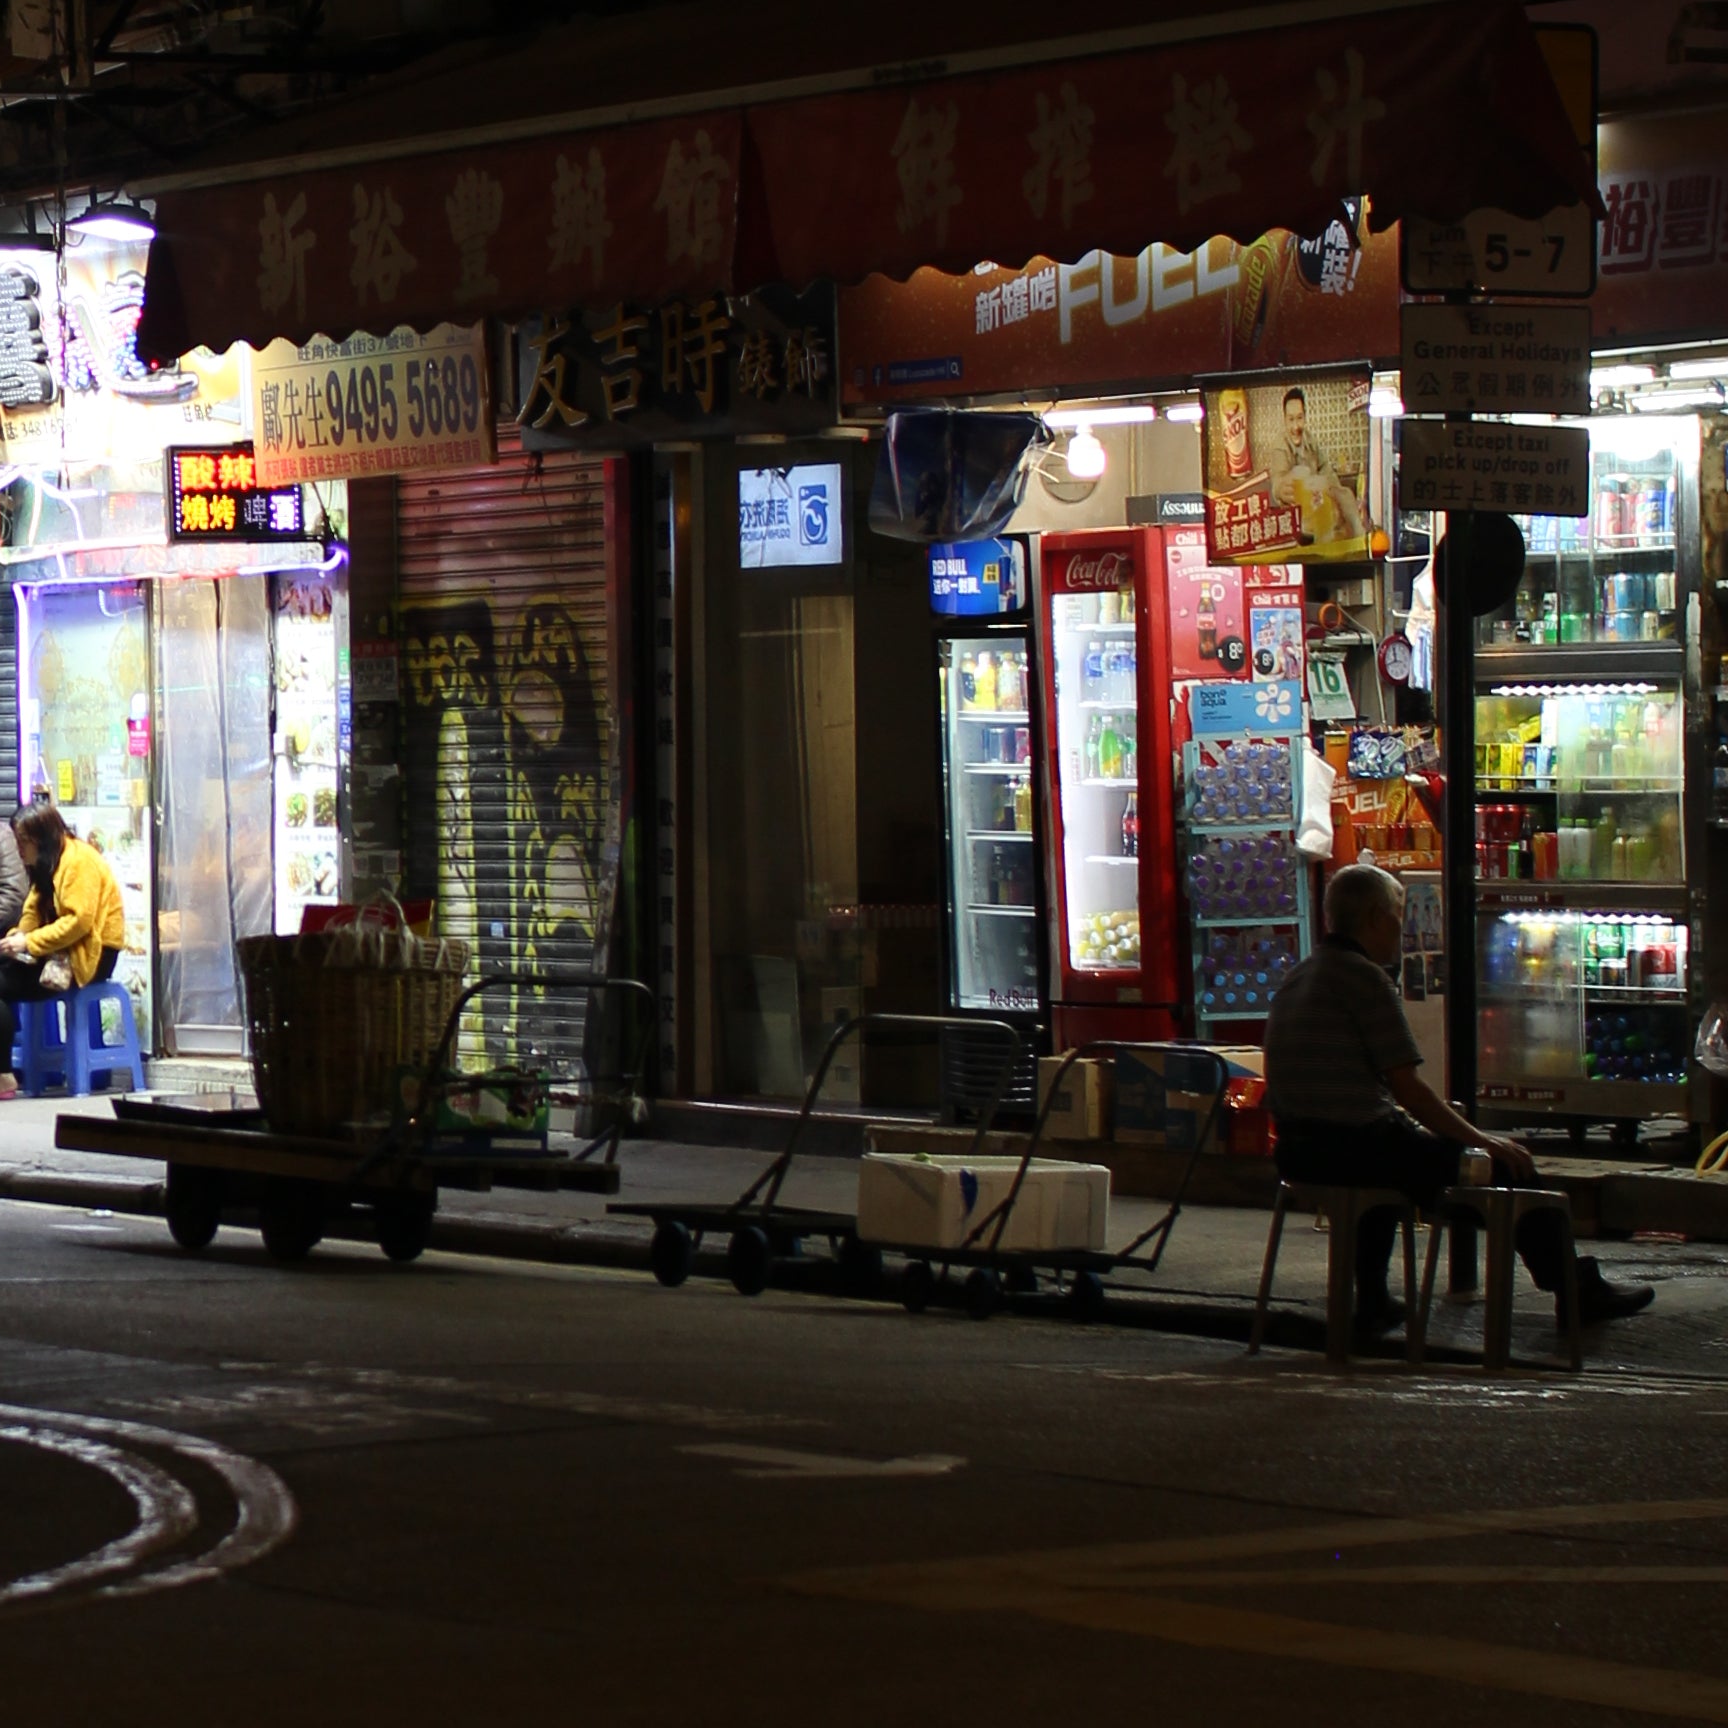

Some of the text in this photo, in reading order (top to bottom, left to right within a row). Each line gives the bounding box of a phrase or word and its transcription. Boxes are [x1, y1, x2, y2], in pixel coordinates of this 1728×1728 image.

[1059, 240, 1241, 346] FUEL
[1468, 319, 1534, 340] Except
[1414, 340, 1582, 365] General Holidays
[326, 362, 399, 446] 9495
[406, 353, 480, 438] 5689
[1453, 429, 1550, 453] Except taxi
[179, 454, 256, 491] 酸辣
[1425, 452, 1570, 476] pick up/drop off
[181, 494, 236, 531] 燒烤
[1309, 659, 1341, 693] 16
